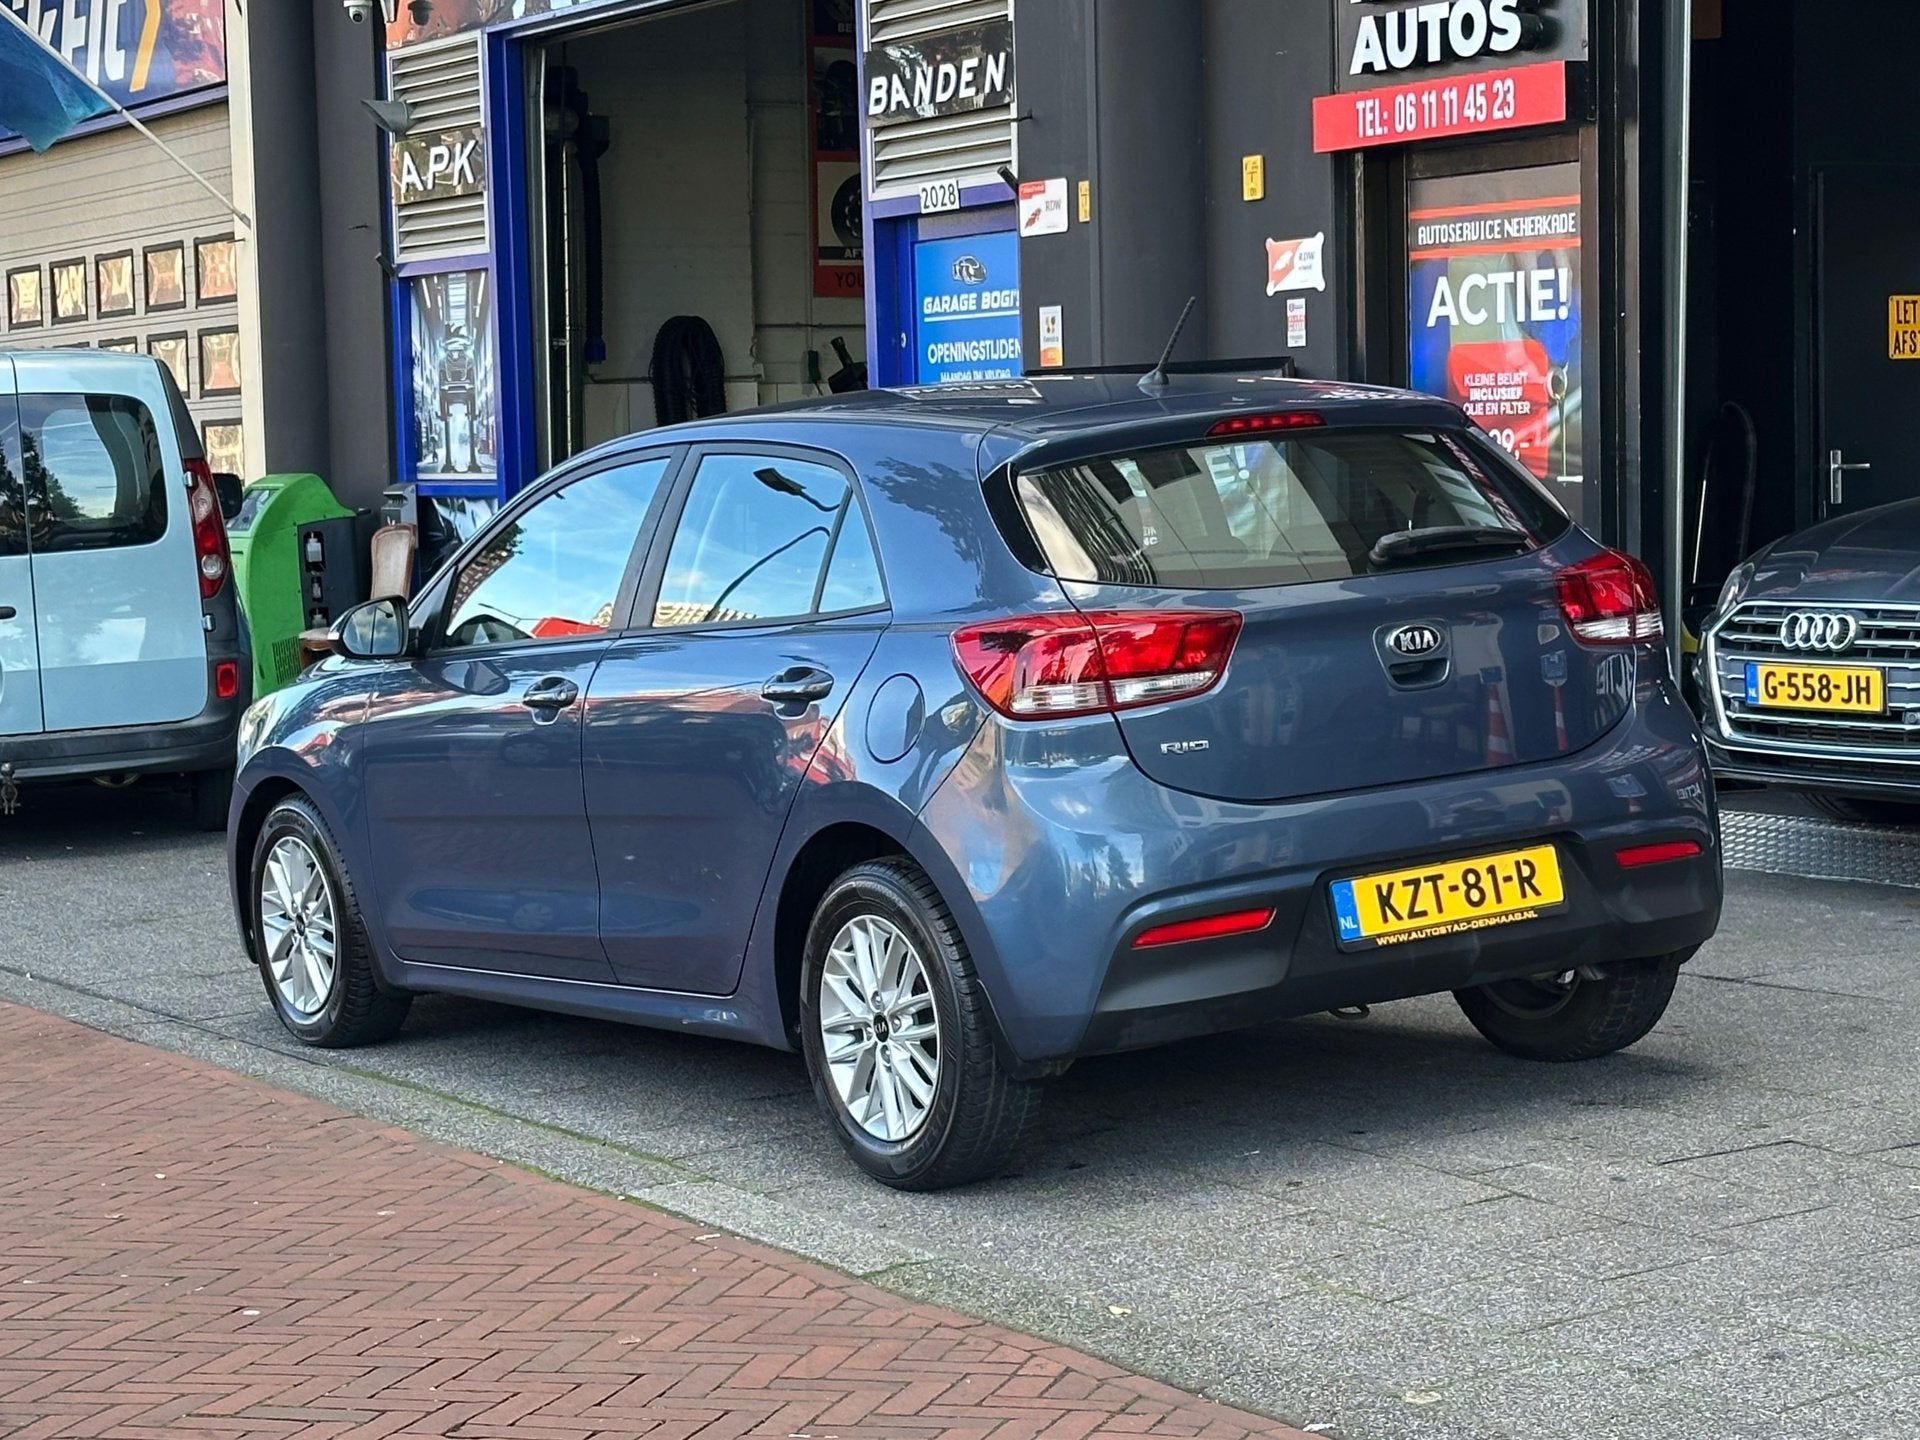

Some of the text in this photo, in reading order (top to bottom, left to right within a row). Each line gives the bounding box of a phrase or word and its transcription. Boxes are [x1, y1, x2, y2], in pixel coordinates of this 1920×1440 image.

[1350, 0, 1522, 75] AUTOS
[868, 52, 1006, 116] BANDEN
[1355, 77, 1515, 138] TEL: 06 11 11 45 23
[401, 139, 477, 194] APK
[921, 183, 957, 210] 2028
[1418, 212, 1577, 245] AUTOSERVICE NEHERKADE
[923, 292, 977, 314] GARAGE
[1426, 267, 1569, 327] ACTIE!
[1896, 300, 1918, 324] LET
[1463, 370, 1528, 387] KLEINE BEURT
[1469, 387, 1523, 401] INCLUSIEF
[1485, 402, 1498, 415] EN
[1500, 401, 1530, 415] FILTER
[1398, 630, 1435, 651] KIA
[1764, 671, 1871, 705] G-558-JH
[1160, 740, 1210, 754] RIO
[1340, 858, 1541, 929] NL KZT-81-R
